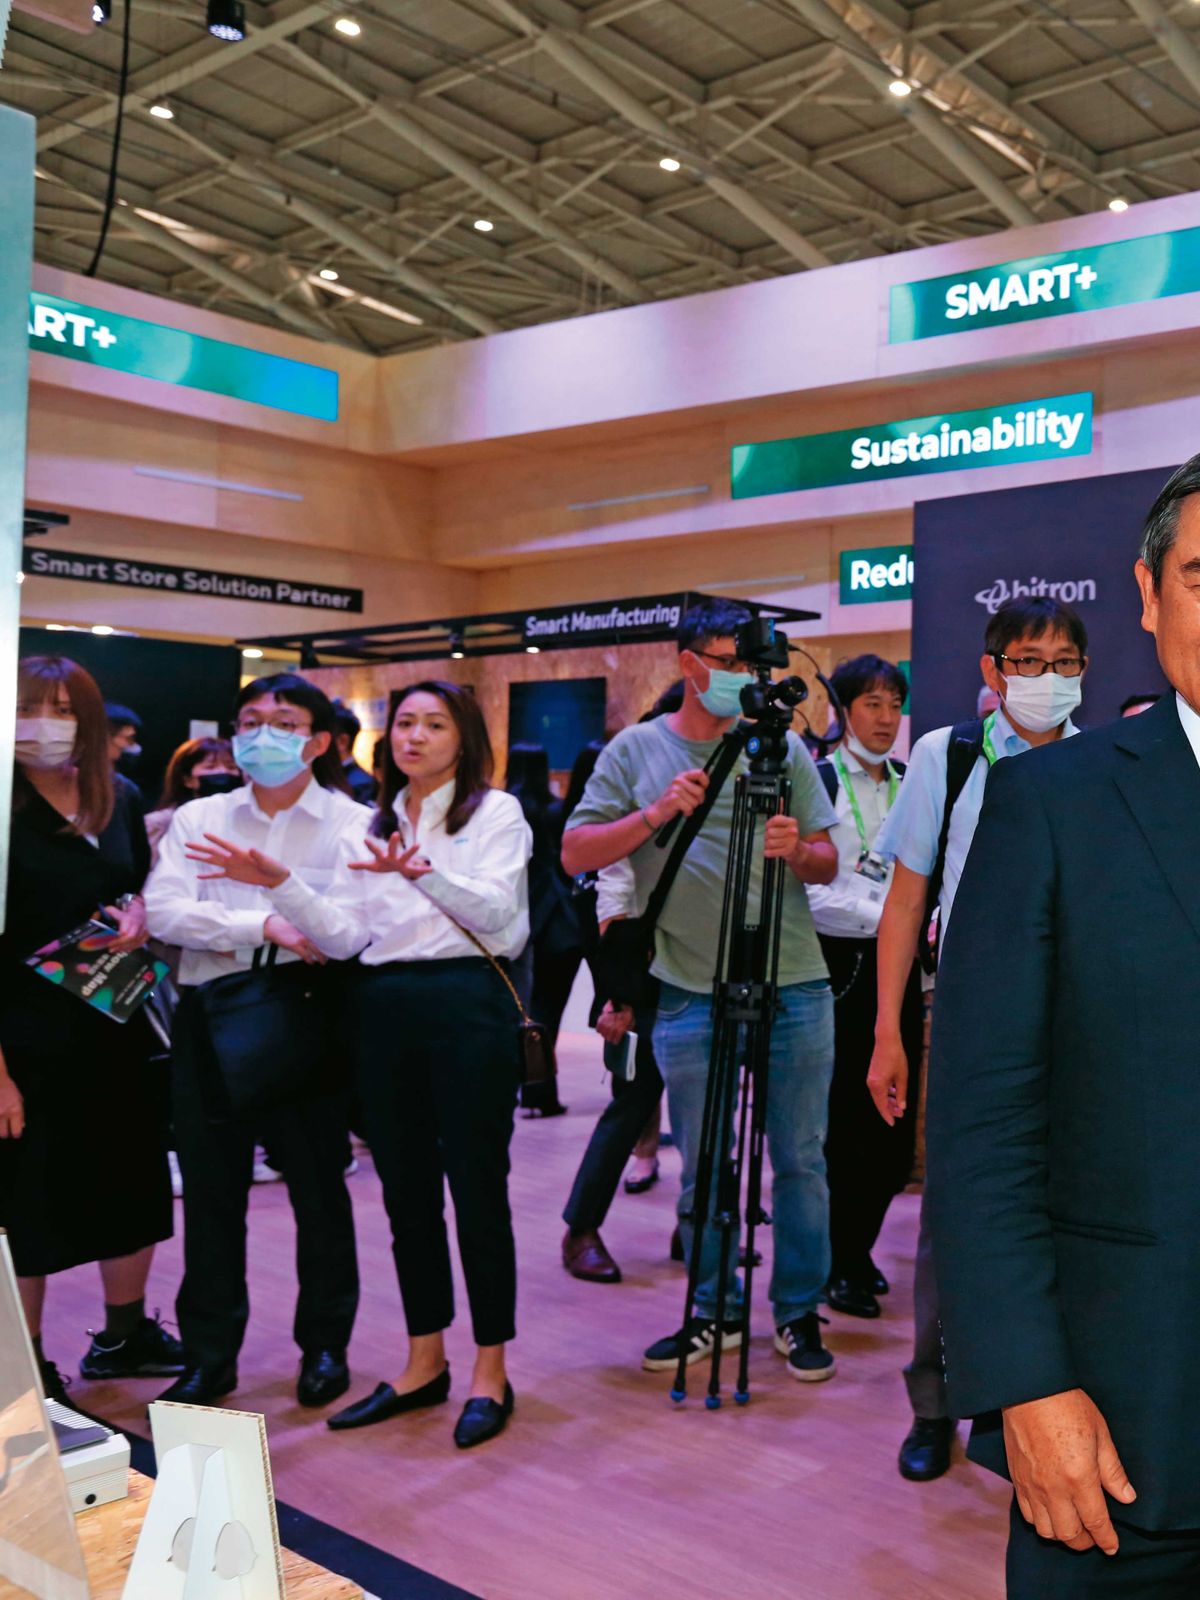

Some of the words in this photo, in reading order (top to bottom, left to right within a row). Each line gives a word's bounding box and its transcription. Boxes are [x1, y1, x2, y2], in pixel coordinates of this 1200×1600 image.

[945, 262, 1098, 320] SMART+
[28, 304, 117, 349] RT+
[850, 408, 1085, 470] Sustainability
[31, 551, 109, 580] Smart
[113, 562, 178, 588] Store
[183, 570, 272, 600] Solution
[276, 582, 353, 610] Partner
[526, 615, 569, 637] Smart
[571, 603, 681, 632] Manufacturing
